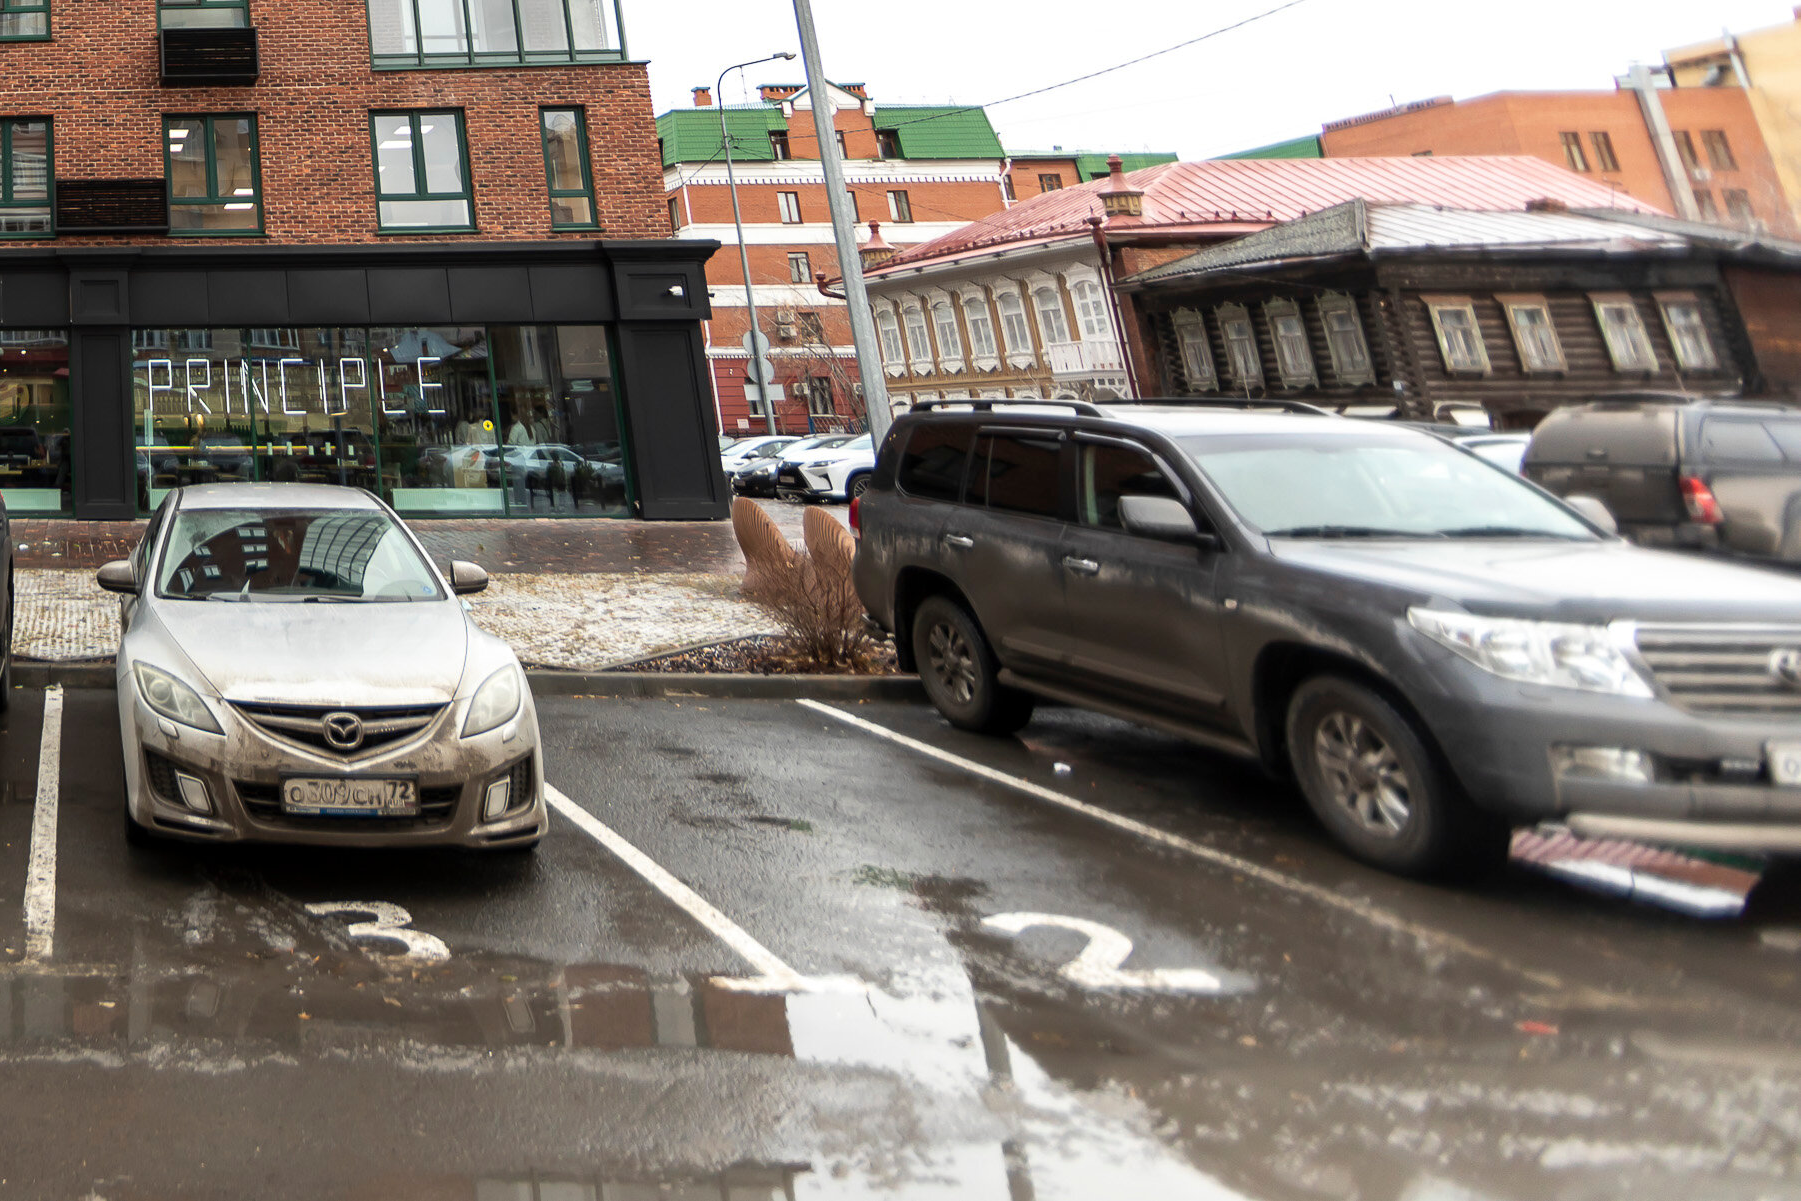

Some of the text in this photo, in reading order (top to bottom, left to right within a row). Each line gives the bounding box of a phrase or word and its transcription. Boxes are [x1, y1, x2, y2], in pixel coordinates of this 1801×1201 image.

[148, 356, 446, 414] PRINCIPLE
[387, 782, 410, 800] 72
[303, 900, 452, 964] 3
[980, 911, 1229, 990] 2
